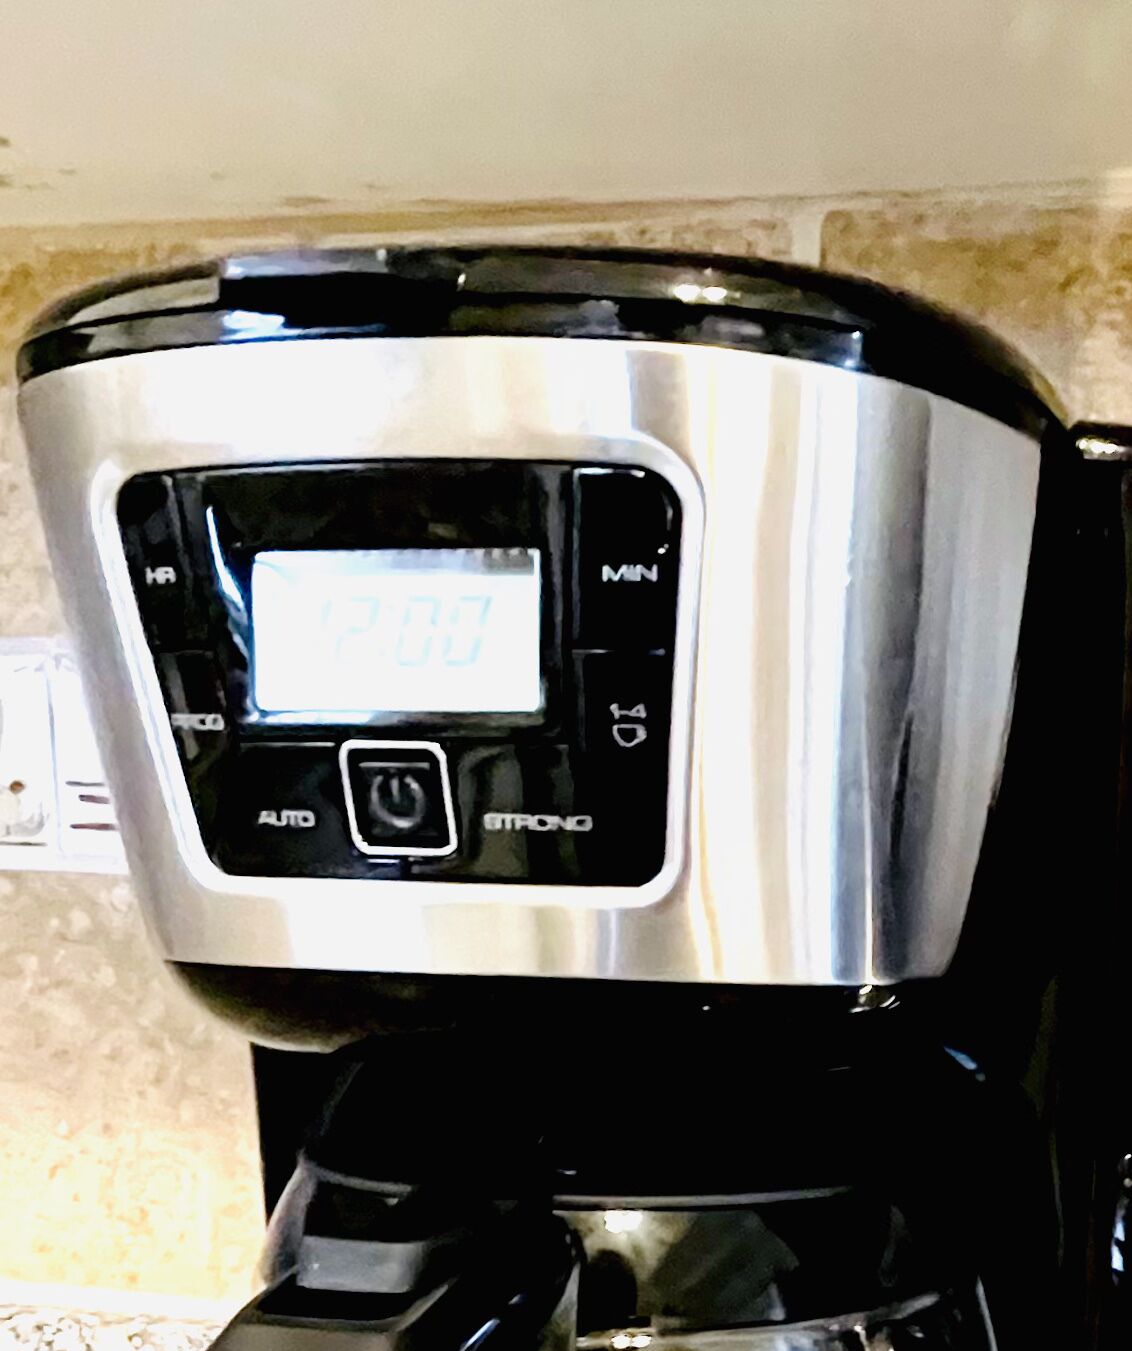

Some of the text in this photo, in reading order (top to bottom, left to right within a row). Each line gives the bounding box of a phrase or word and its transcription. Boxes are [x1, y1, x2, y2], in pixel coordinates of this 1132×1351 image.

[602, 564, 658, 582] MIN
[258, 808, 316, 828] AUTO
[483, 812, 593, 832] STRONG
